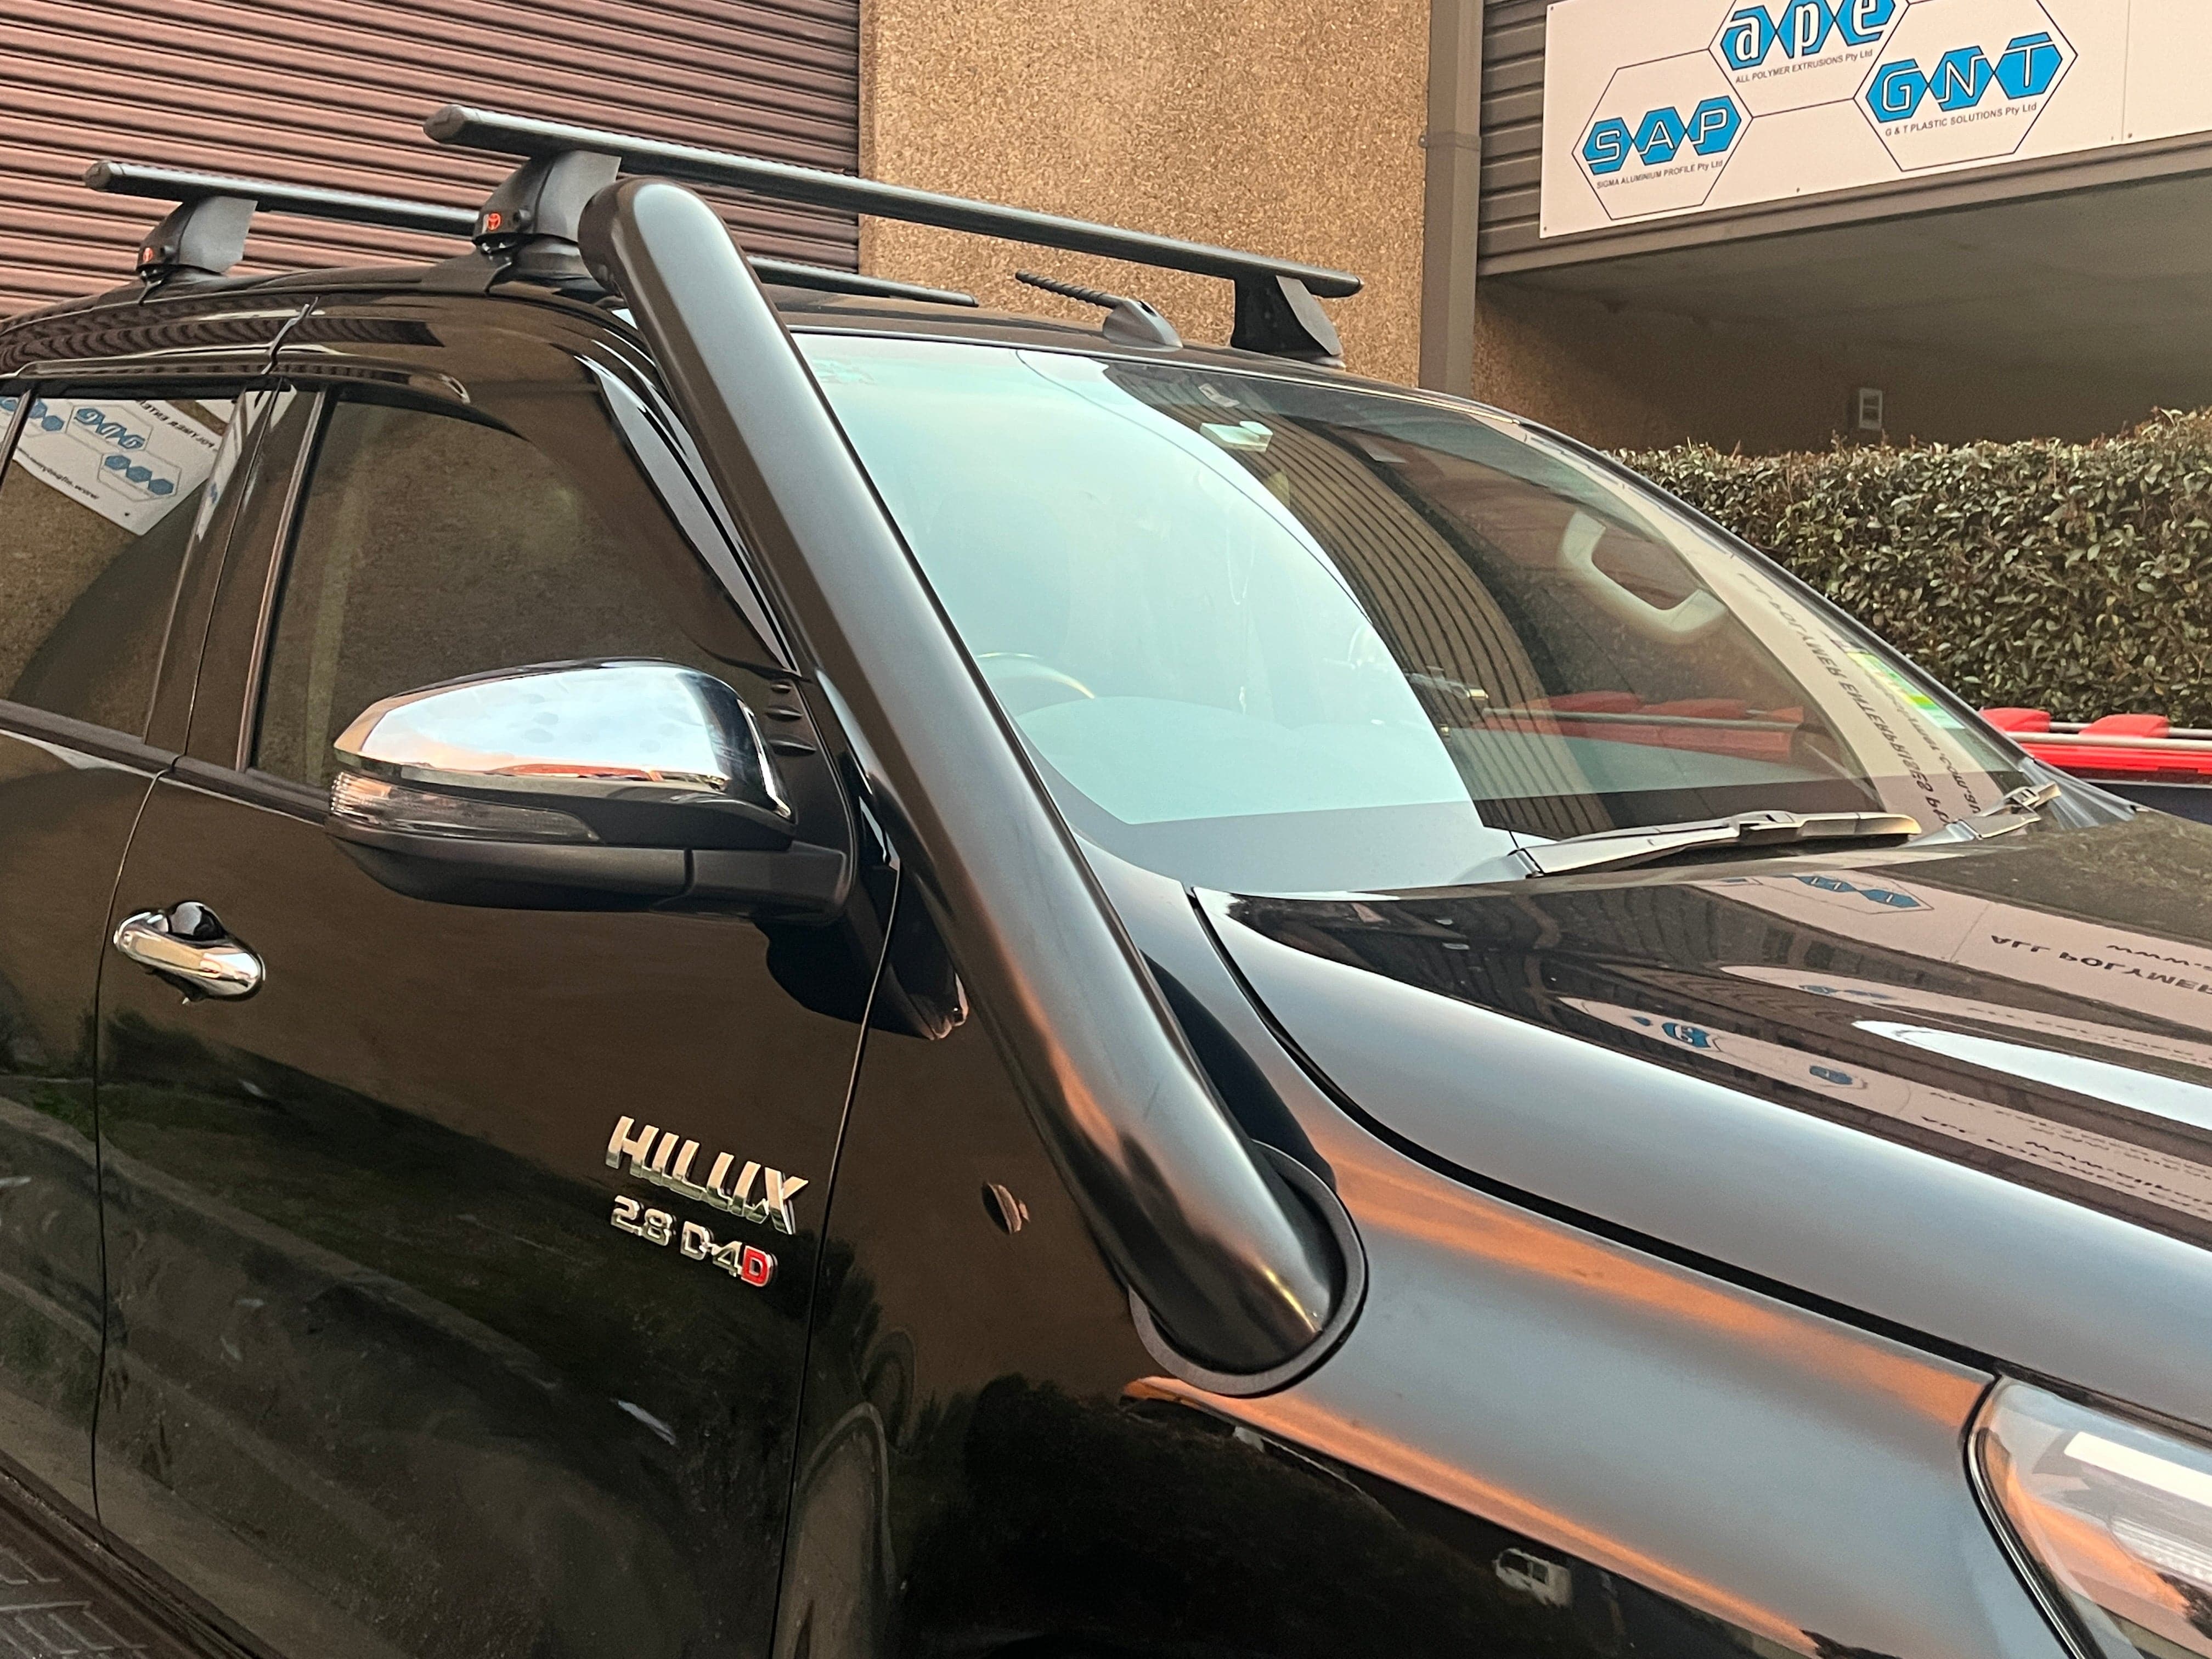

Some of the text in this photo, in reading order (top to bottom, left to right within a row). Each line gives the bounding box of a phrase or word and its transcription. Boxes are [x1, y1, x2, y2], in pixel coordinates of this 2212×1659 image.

[1729, 0, 1884, 63] ape
[1735, 49, 1873, 83] ALL POLYMER EXTRUSIONS Pty Ltd
[1882, 41, 2055, 112] GNT
[1588, 108, 1728, 165] SAP
[1885, 103, 2037, 137] G & T PLASTIC SOLUTIONS Pty Ltd
[1596, 160, 1723, 189] SIGMA ALUMINIUM PROFILE Pty Ltd
[605, 1115, 809, 1235] HILUX
[680, 1221, 775, 1287] D-4D
